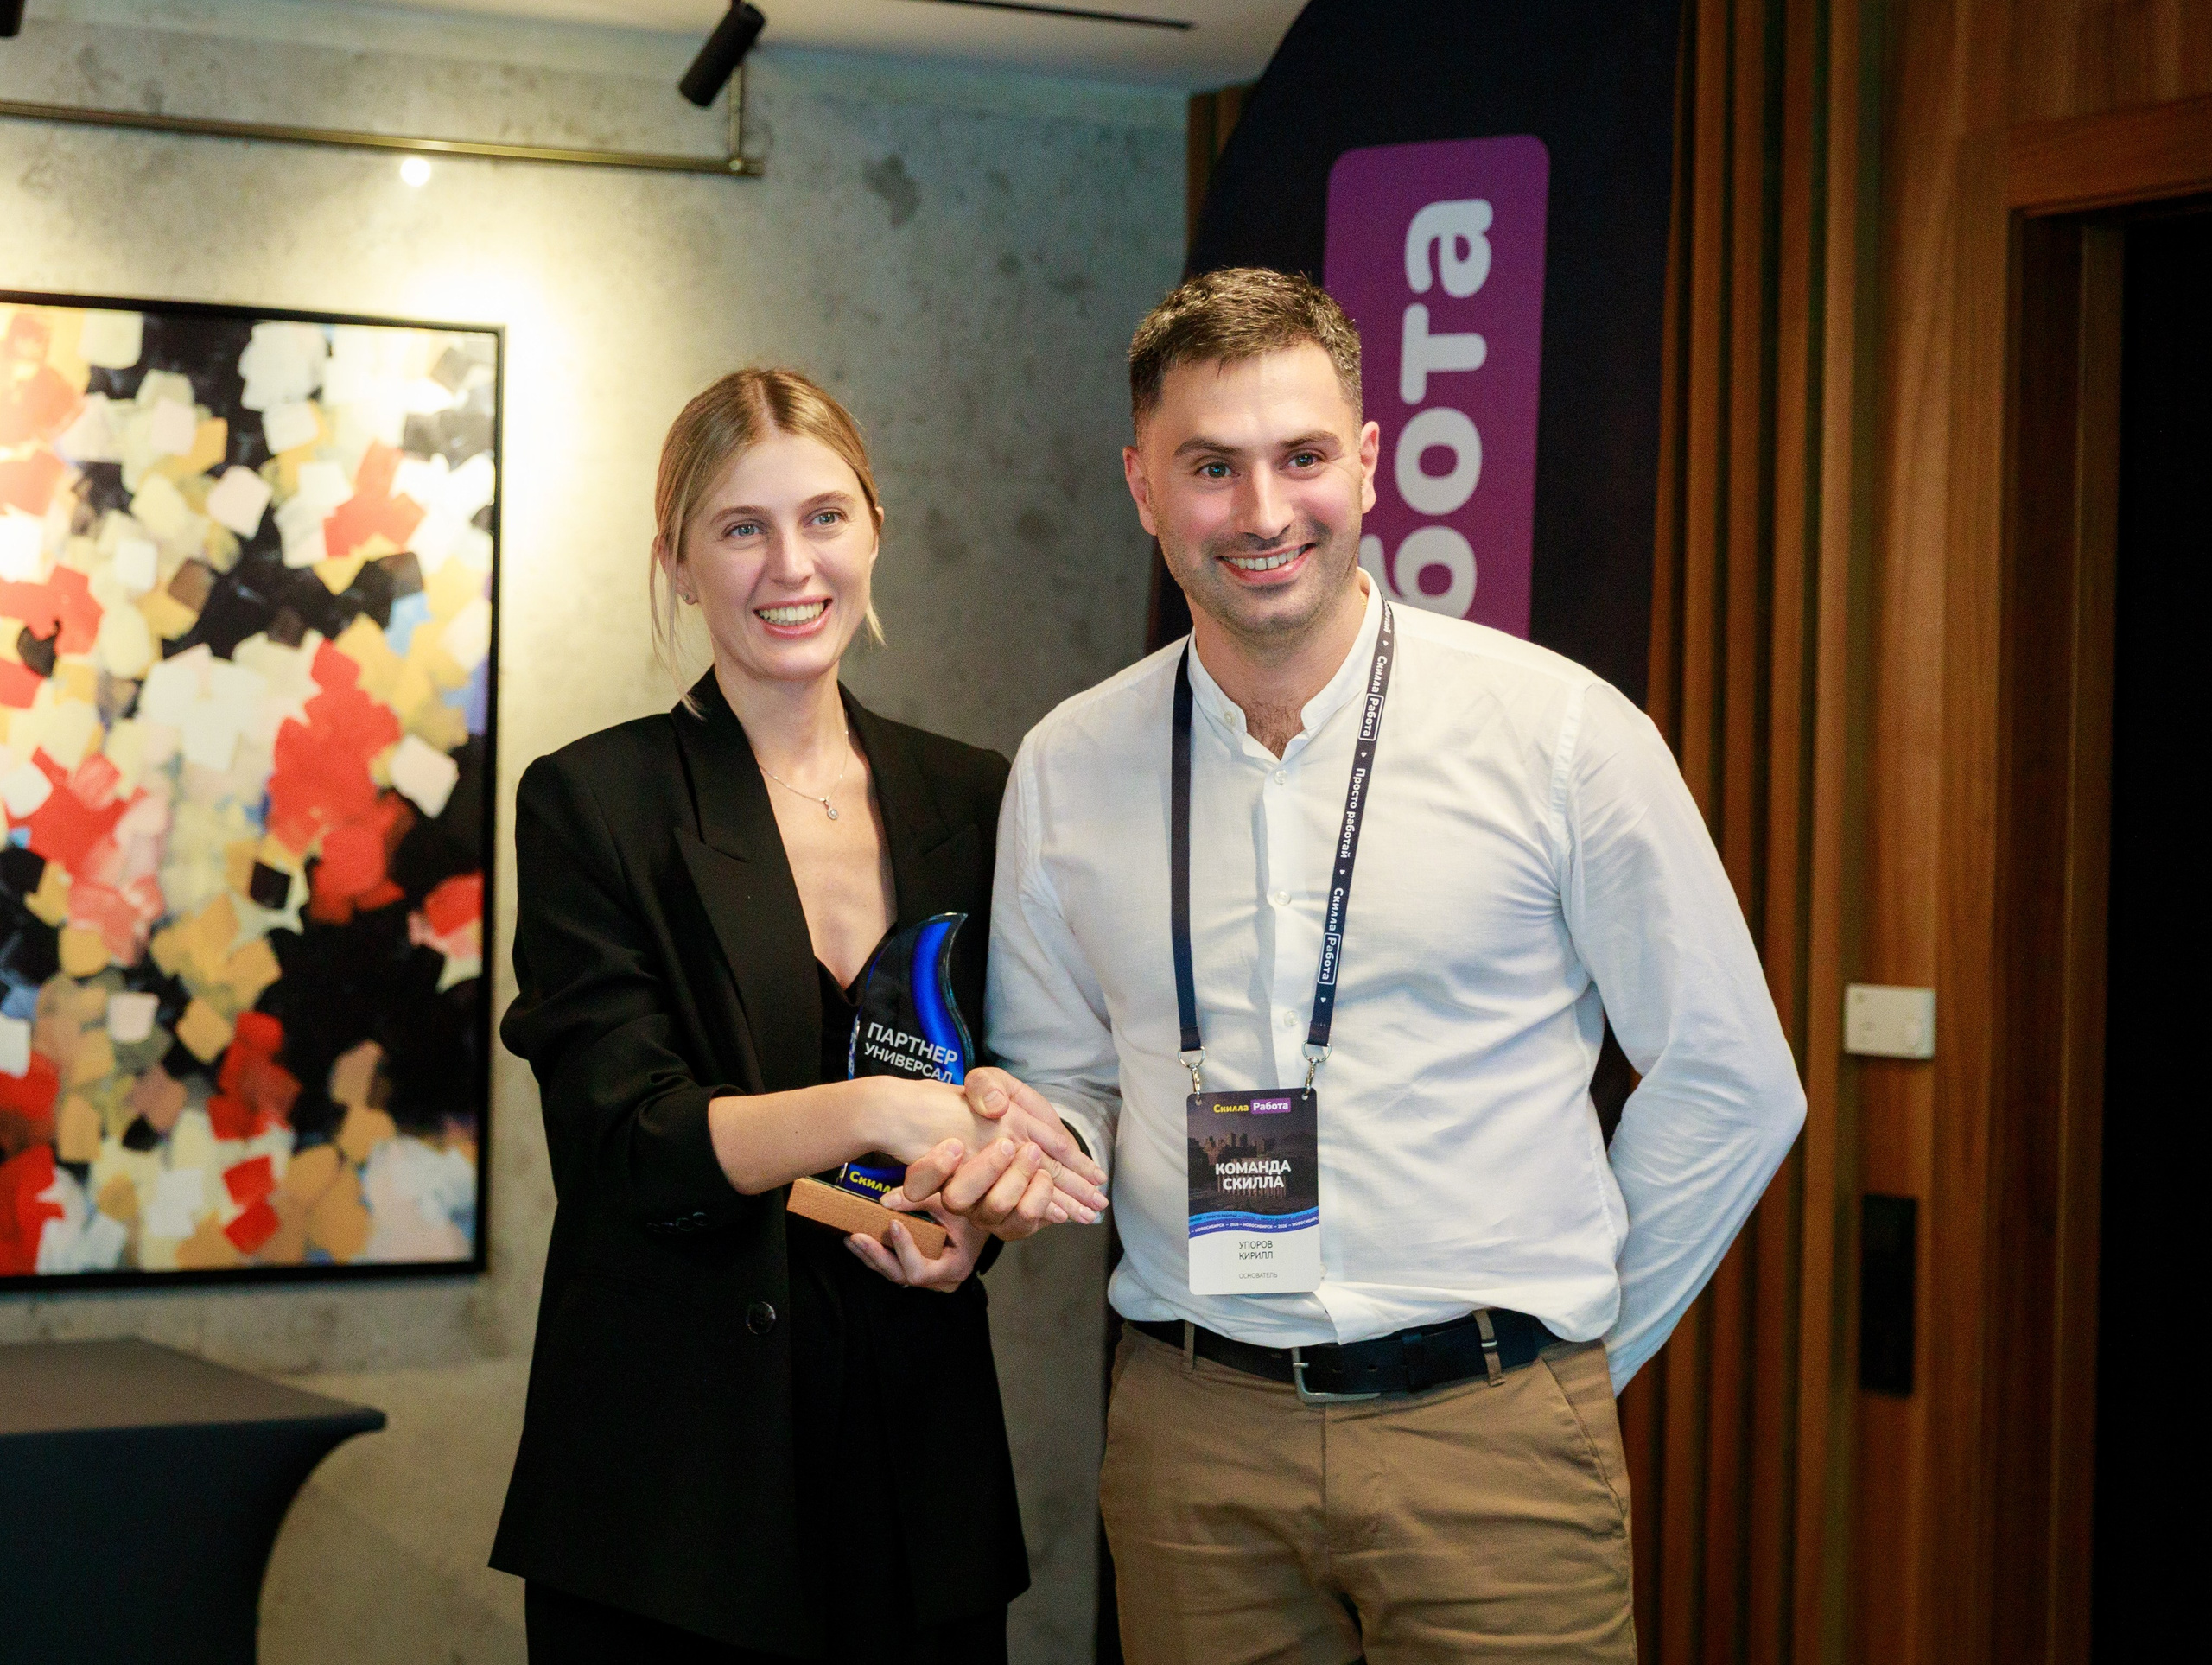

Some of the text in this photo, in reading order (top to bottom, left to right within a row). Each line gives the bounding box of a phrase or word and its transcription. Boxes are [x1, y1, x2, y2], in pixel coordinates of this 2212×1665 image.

[1359, 199, 1493, 620] бота
[1371, 655, 1388, 693] Скилла
[1363, 696, 1380, 737] Работа
[1350, 767, 1366, 809] Просто
[1340, 810, 1356, 859] работай
[1329, 887, 1344, 931] Скилла
[1322, 937, 1337, 981] Работа
[864, 1042, 953, 1084] УНИВЕРСАЛ
[867, 1021, 958, 1065] ПАРТНЕР
[1213, 1101, 1288, 1113] Скилла Работа
[849, 1171, 891, 1192] Скилл
[1215, 1160, 1292, 1176] КОМАНДА
[1223, 1175, 1285, 1191] СКИЛЛА
[1238, 1240, 1274, 1250] УПОРОВ
[1238, 1251, 1274, 1260] КИРИЛЛ
